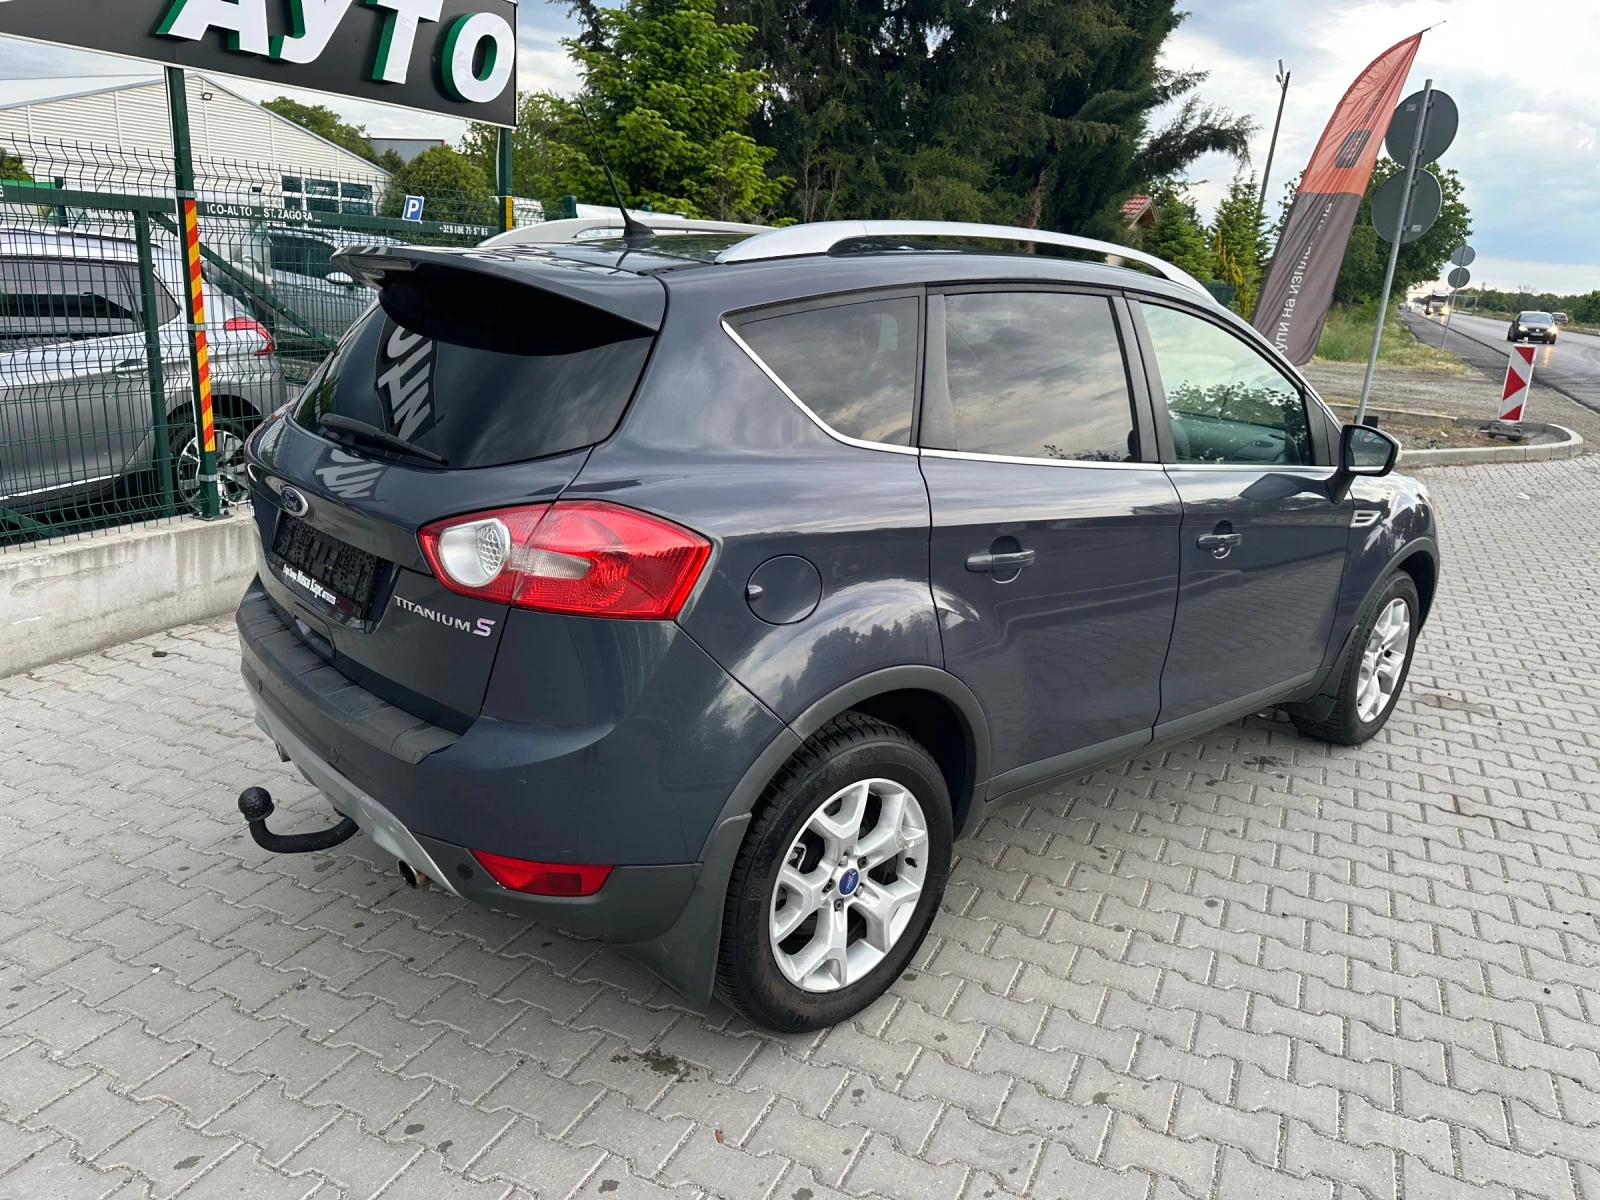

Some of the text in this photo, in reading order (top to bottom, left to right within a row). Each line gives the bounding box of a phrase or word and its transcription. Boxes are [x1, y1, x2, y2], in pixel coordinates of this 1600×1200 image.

[407, 199, 419, 218] P
[1282, 299, 1296, 318] на
[1275, 322, 1290, 353] упи
[394, 595, 496, 637] TITANIUM S
